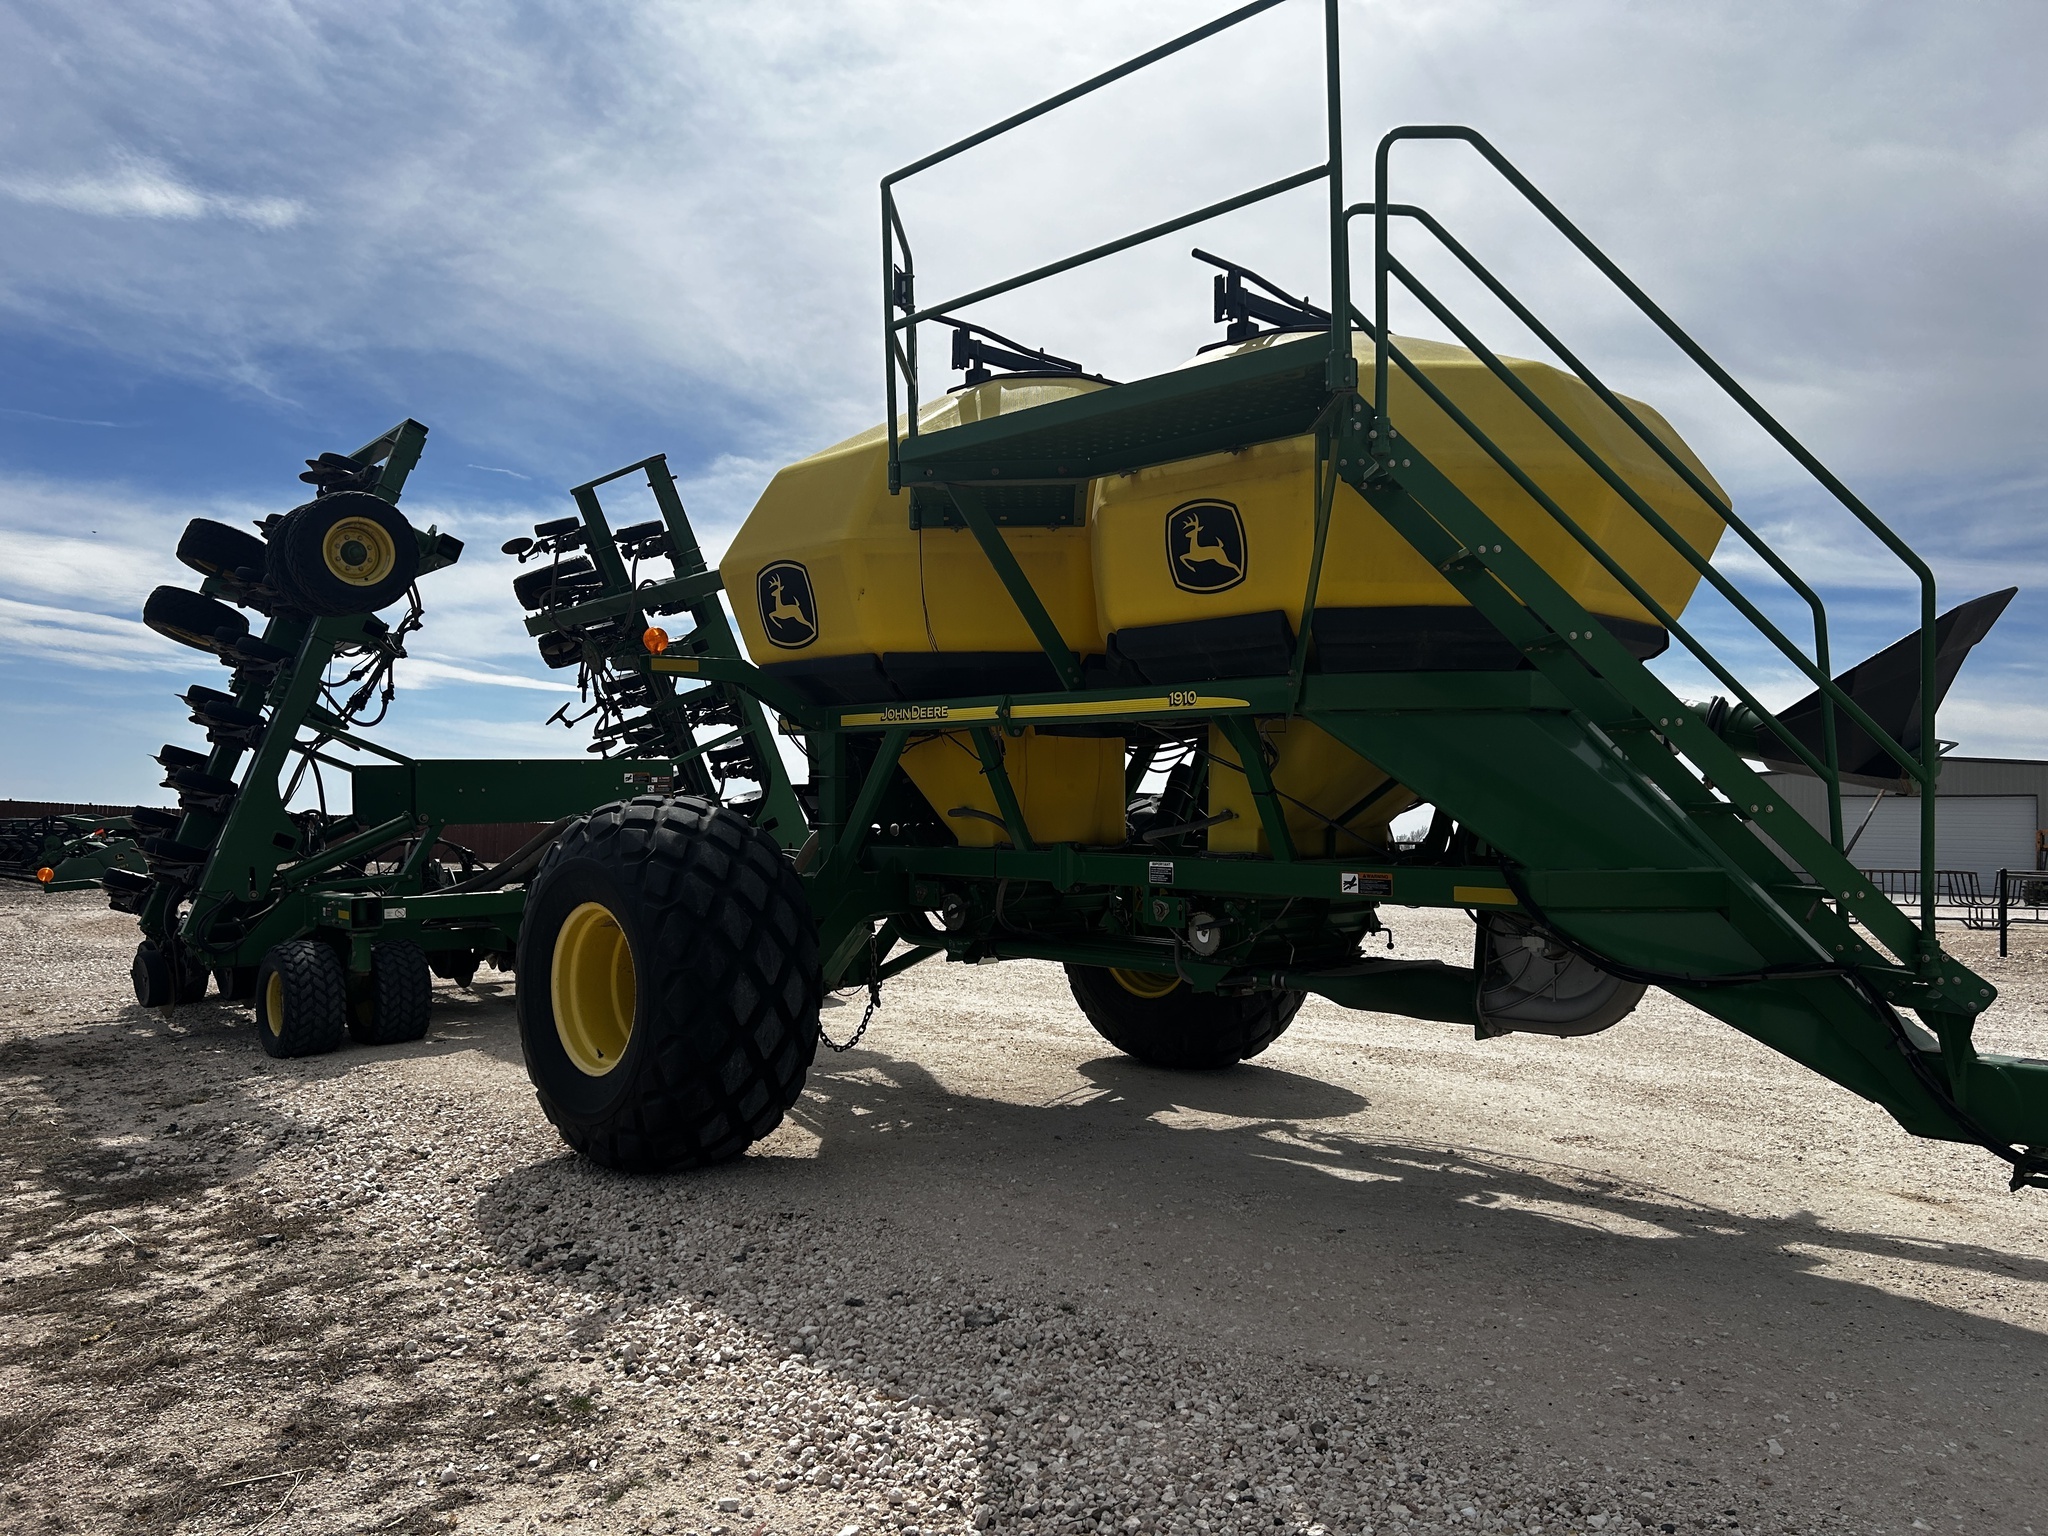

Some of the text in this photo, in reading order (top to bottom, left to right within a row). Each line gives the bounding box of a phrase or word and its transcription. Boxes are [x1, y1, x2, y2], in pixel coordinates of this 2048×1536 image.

[1169, 691, 1197, 705] 1910
[881, 705, 949, 721] JOHN DEERE
